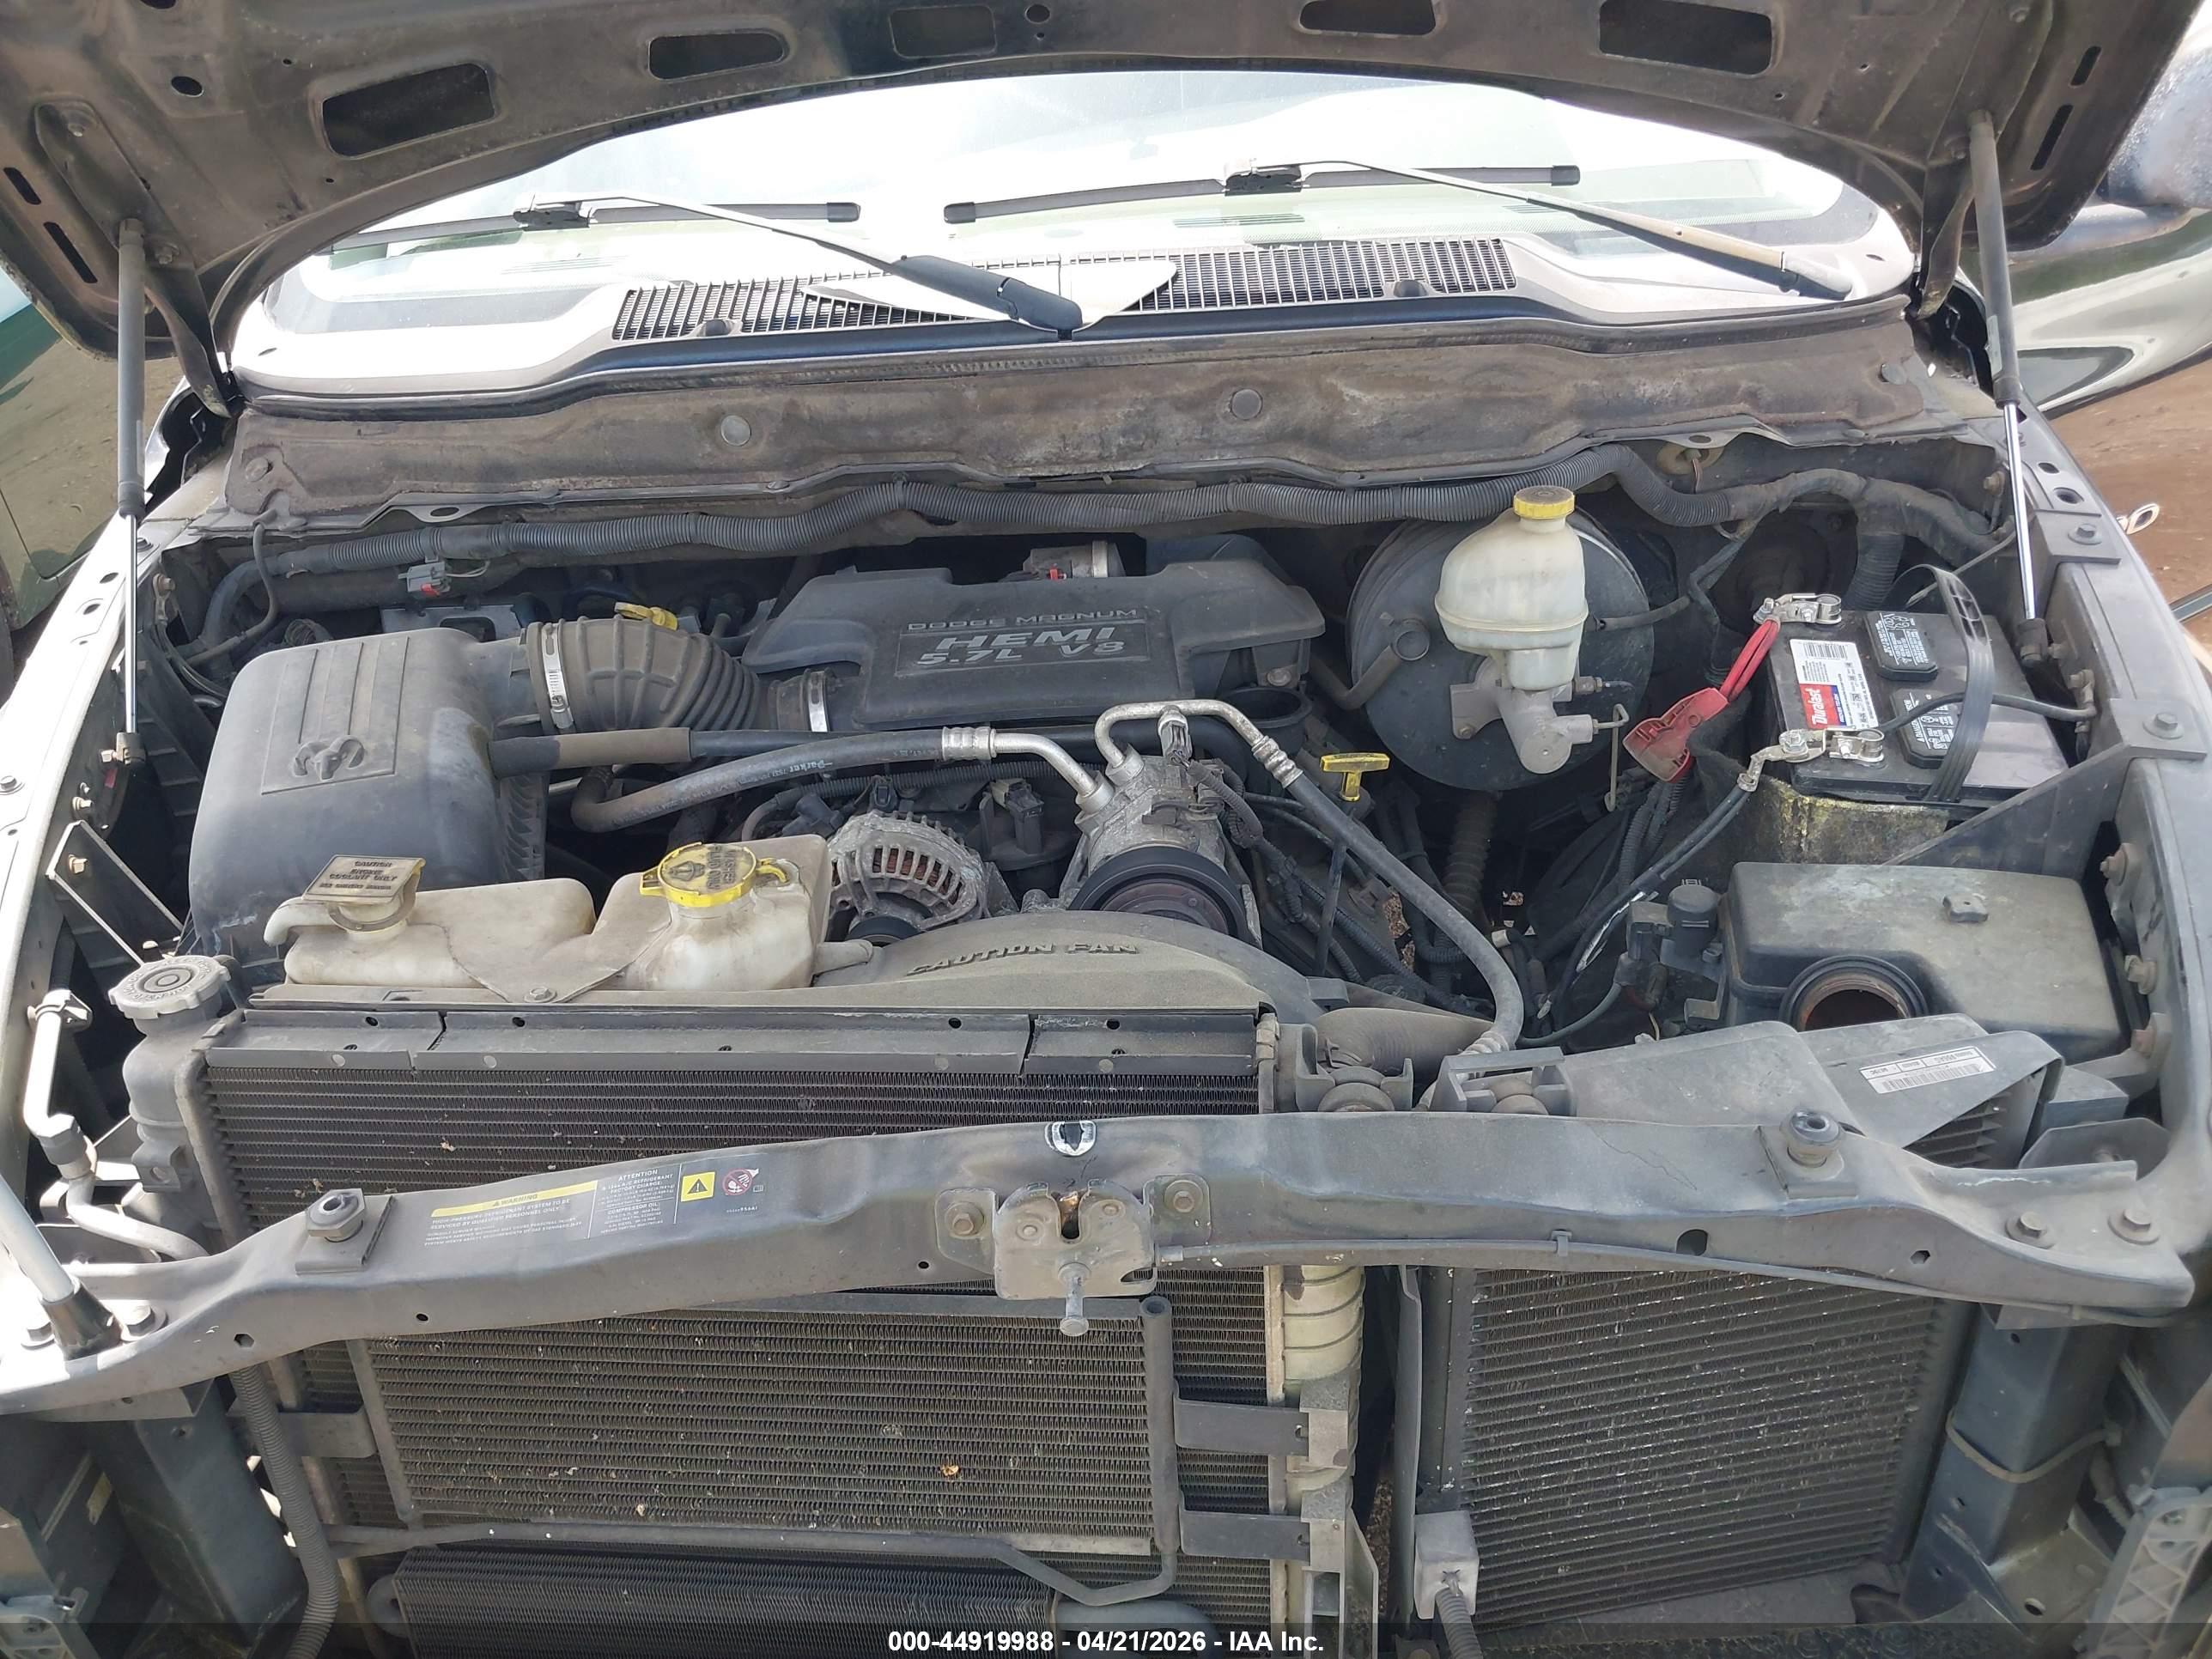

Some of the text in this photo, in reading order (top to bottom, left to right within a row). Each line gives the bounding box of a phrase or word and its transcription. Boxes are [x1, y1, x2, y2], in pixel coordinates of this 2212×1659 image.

[908, 609, 1137, 630] DODGE MAGNUM
[935, 627, 1115, 651] HEMI
[917, 641, 1126, 665] 5.7L V8
[1805, 688, 1828, 726] Duralast
[789, 759, 825, 773] Parker
[907, 943, 1140, 976] CAUTION FAN
[618, 1169, 658, 1182] ATTENTION
[501, 1194, 538, 1205] WARNING
